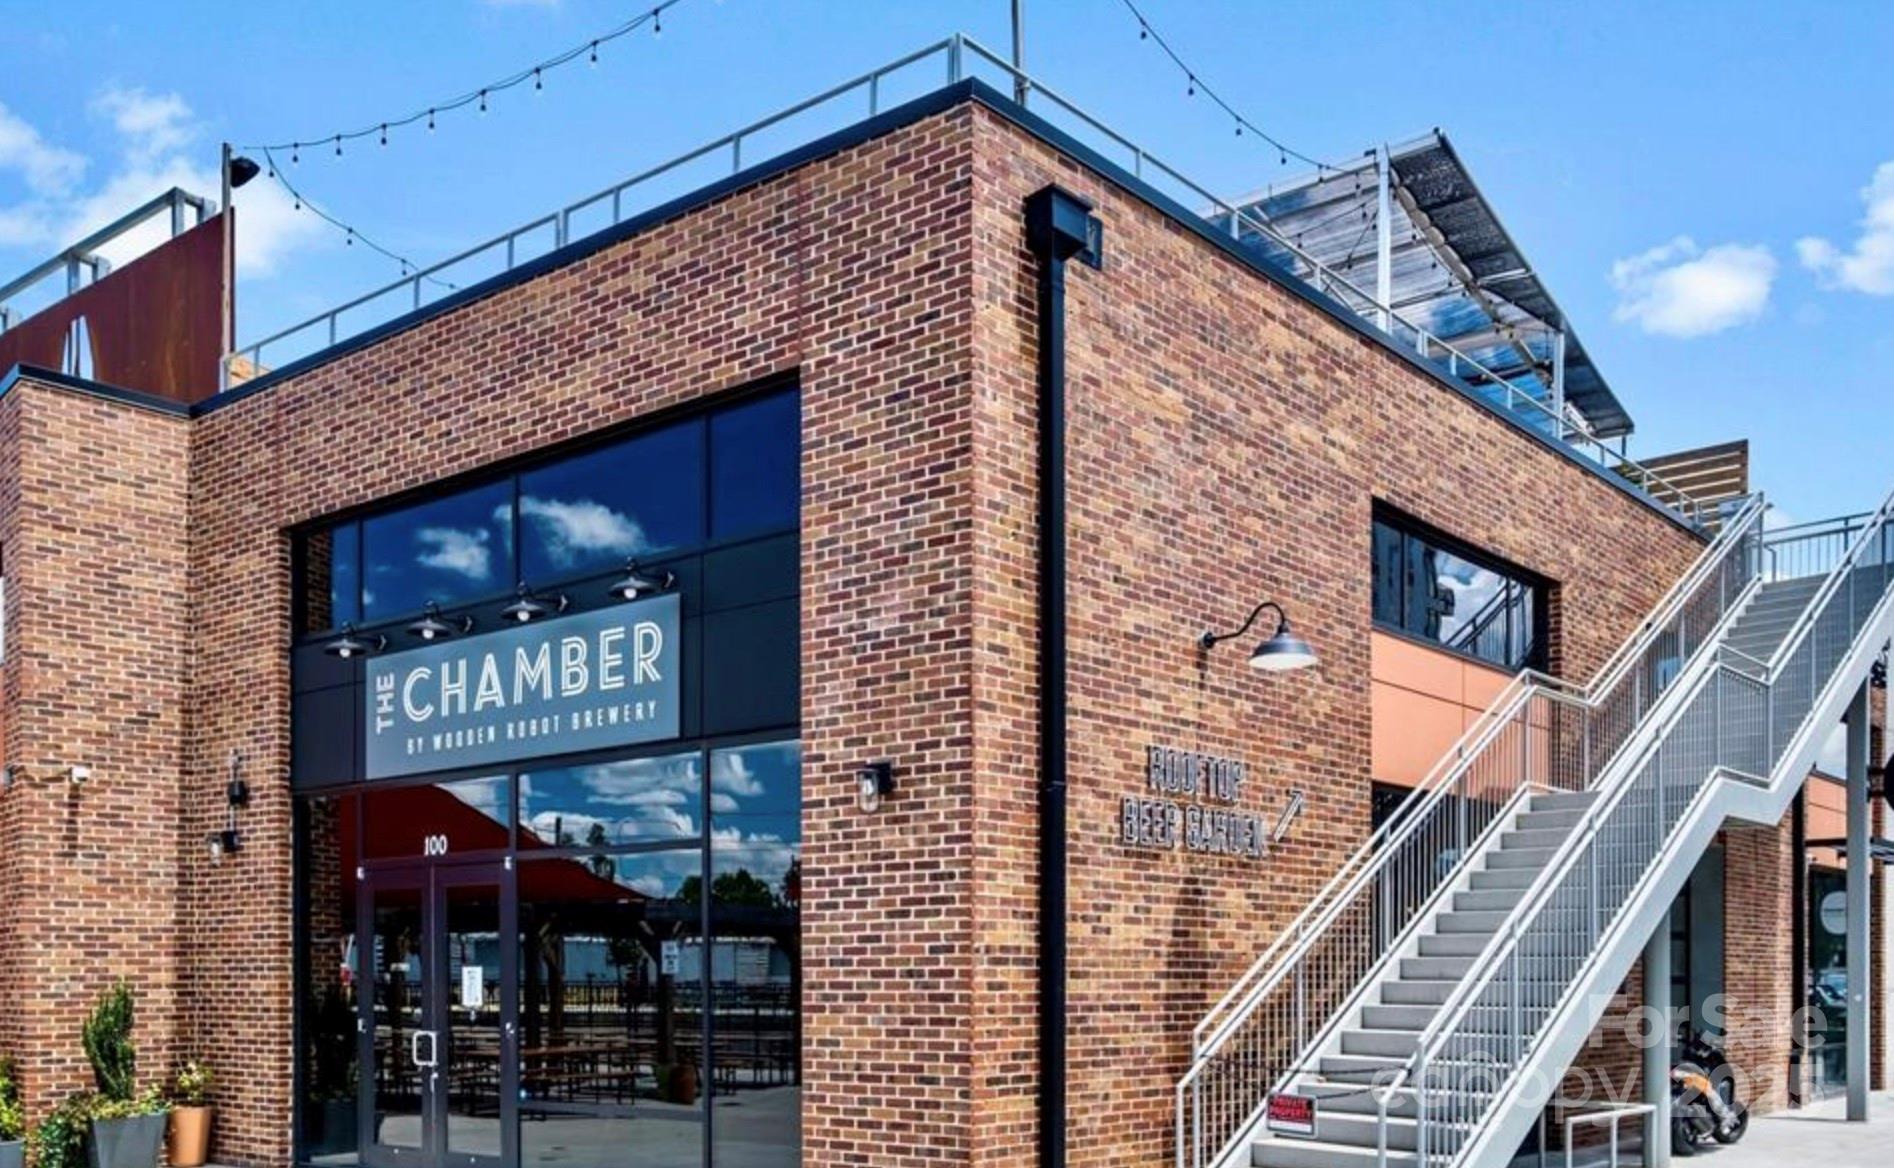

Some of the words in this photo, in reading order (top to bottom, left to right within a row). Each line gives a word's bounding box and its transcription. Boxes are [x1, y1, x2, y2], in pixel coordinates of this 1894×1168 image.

[375, 672, 395, 734] THE
[403, 621, 663, 722] CHAMBER
[407, 737, 423, 755] BY
[433, 725, 495, 751] WOODEN
[507, 715, 560, 740] ROBOT
[571, 700, 656, 731] BREWERY
[1147, 745, 1243, 801] ROOFTOP
[424, 834, 447, 856] 100
[1122, 796, 1180, 849] BEER
[1185, 805, 1266, 856] GARDEN
